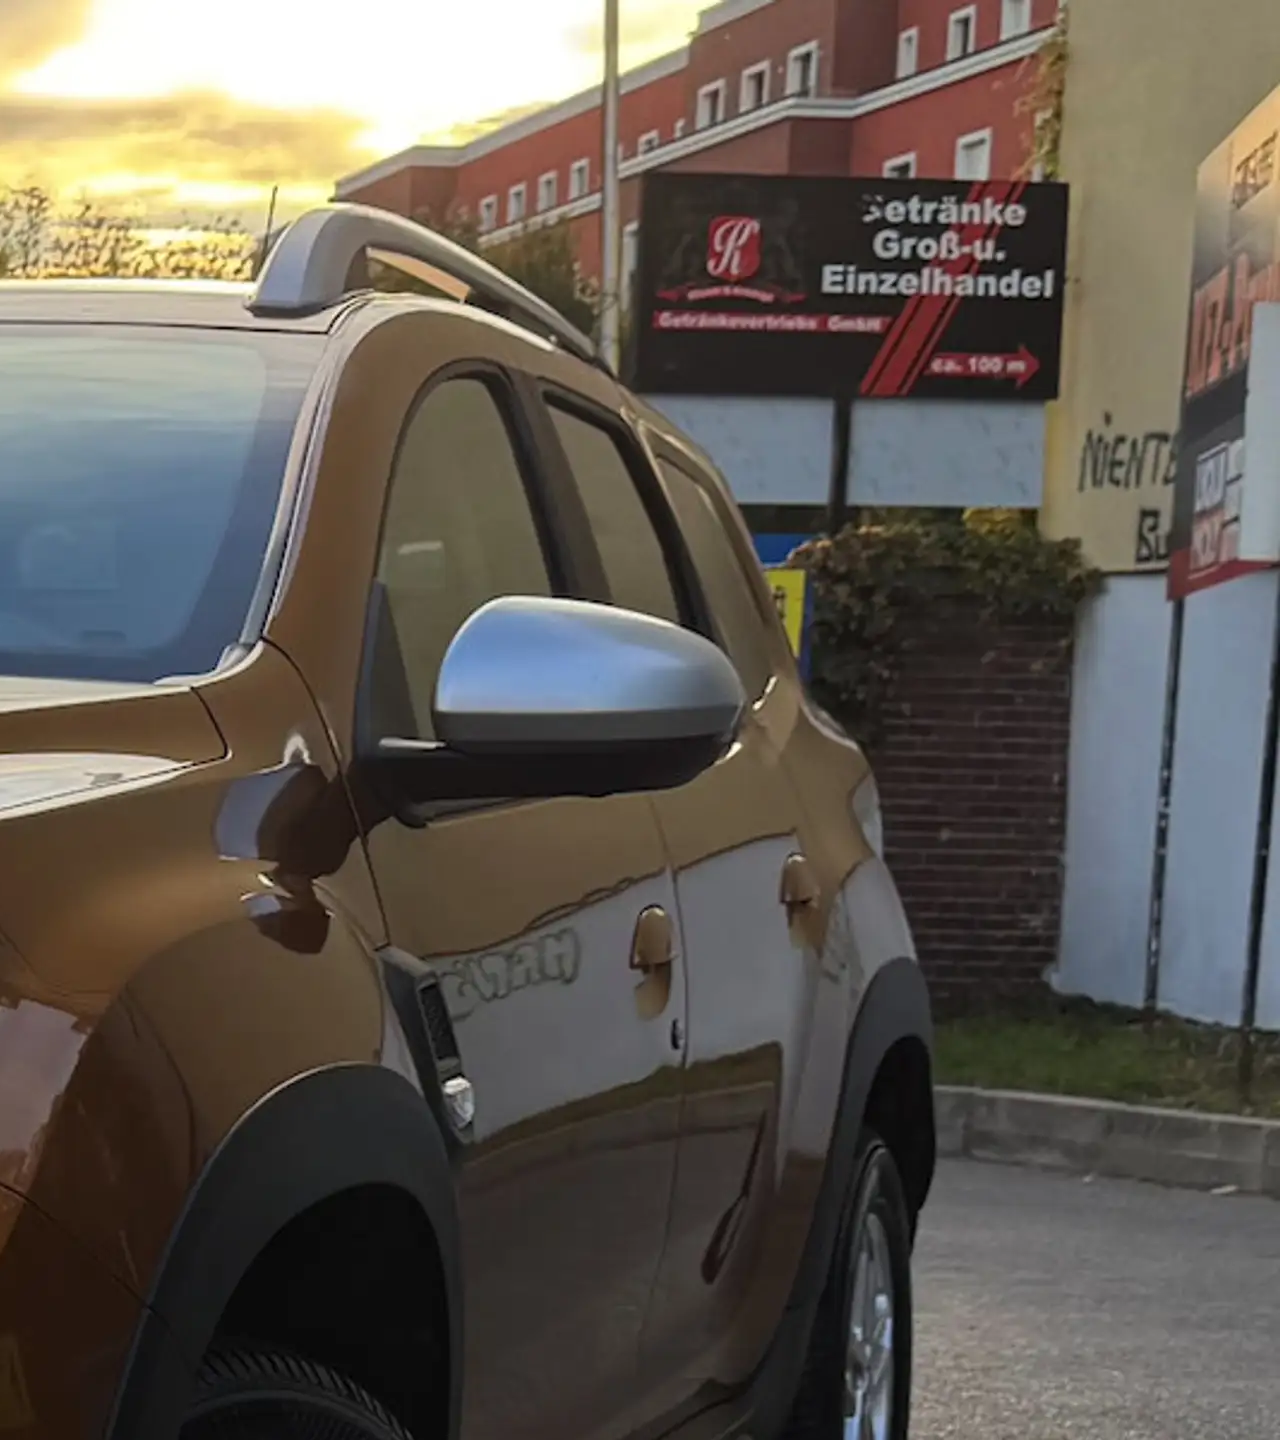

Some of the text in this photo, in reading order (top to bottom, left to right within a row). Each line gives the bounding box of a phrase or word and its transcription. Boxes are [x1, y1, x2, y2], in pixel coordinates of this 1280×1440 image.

[821, 265, 1054, 298] Einzelhandel
[827, 315, 882, 333] GmbH
[969, 356, 1002, 373] 100
[1006, 361, 1026, 373] m
